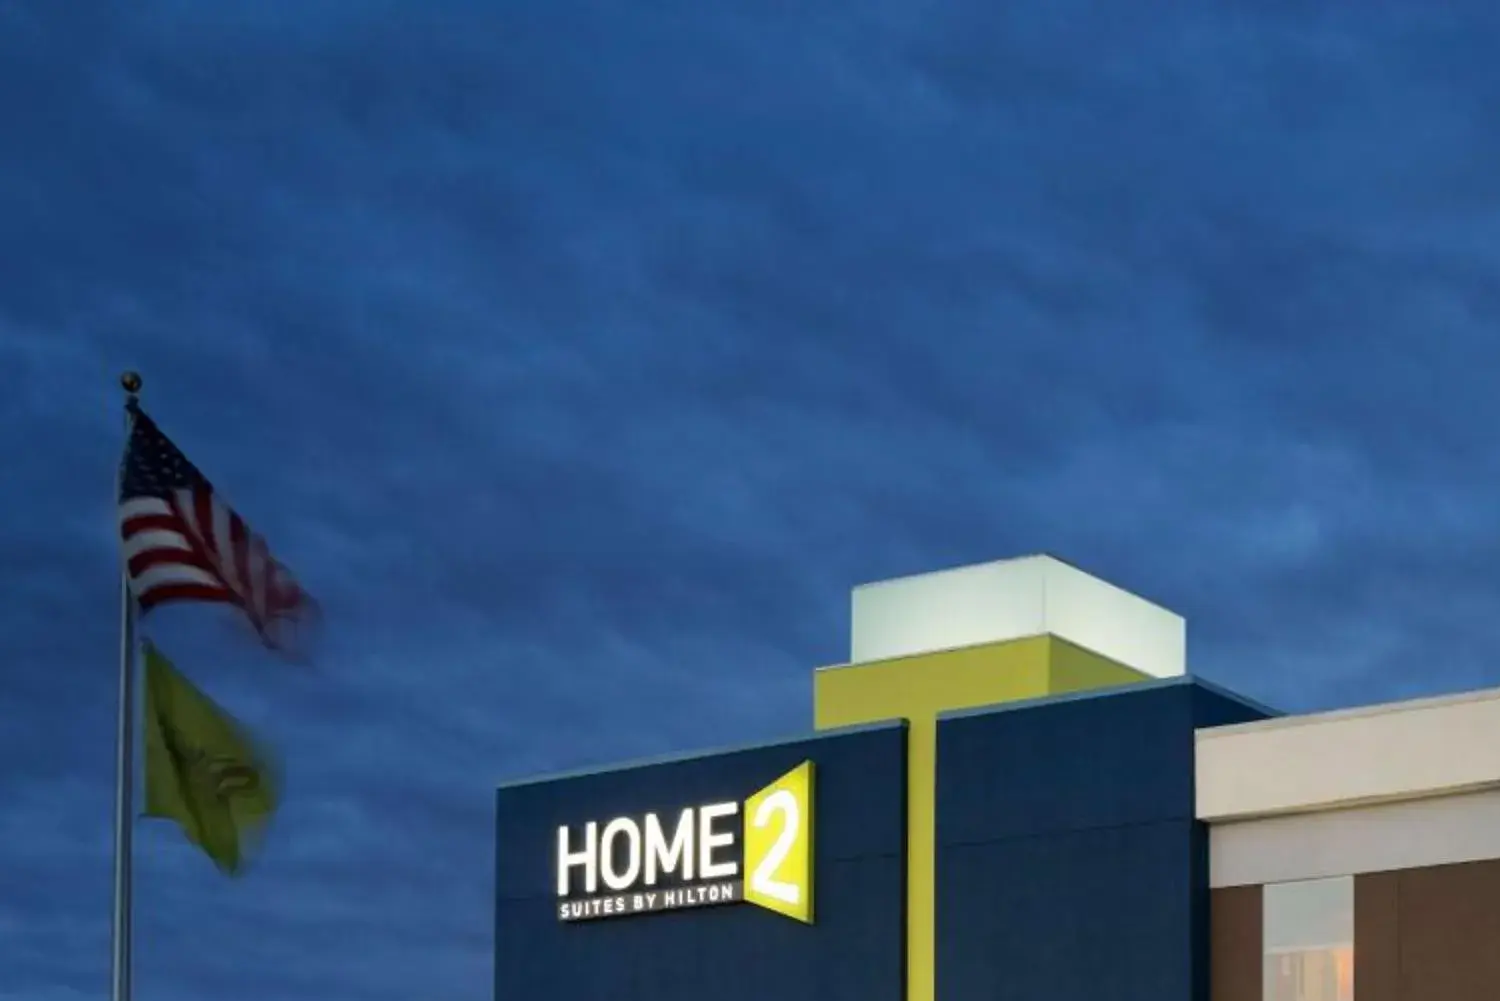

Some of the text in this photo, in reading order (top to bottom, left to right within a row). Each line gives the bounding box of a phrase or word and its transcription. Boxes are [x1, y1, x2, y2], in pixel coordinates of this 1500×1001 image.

[559, 885, 734, 919] SUITES BY HILTON
